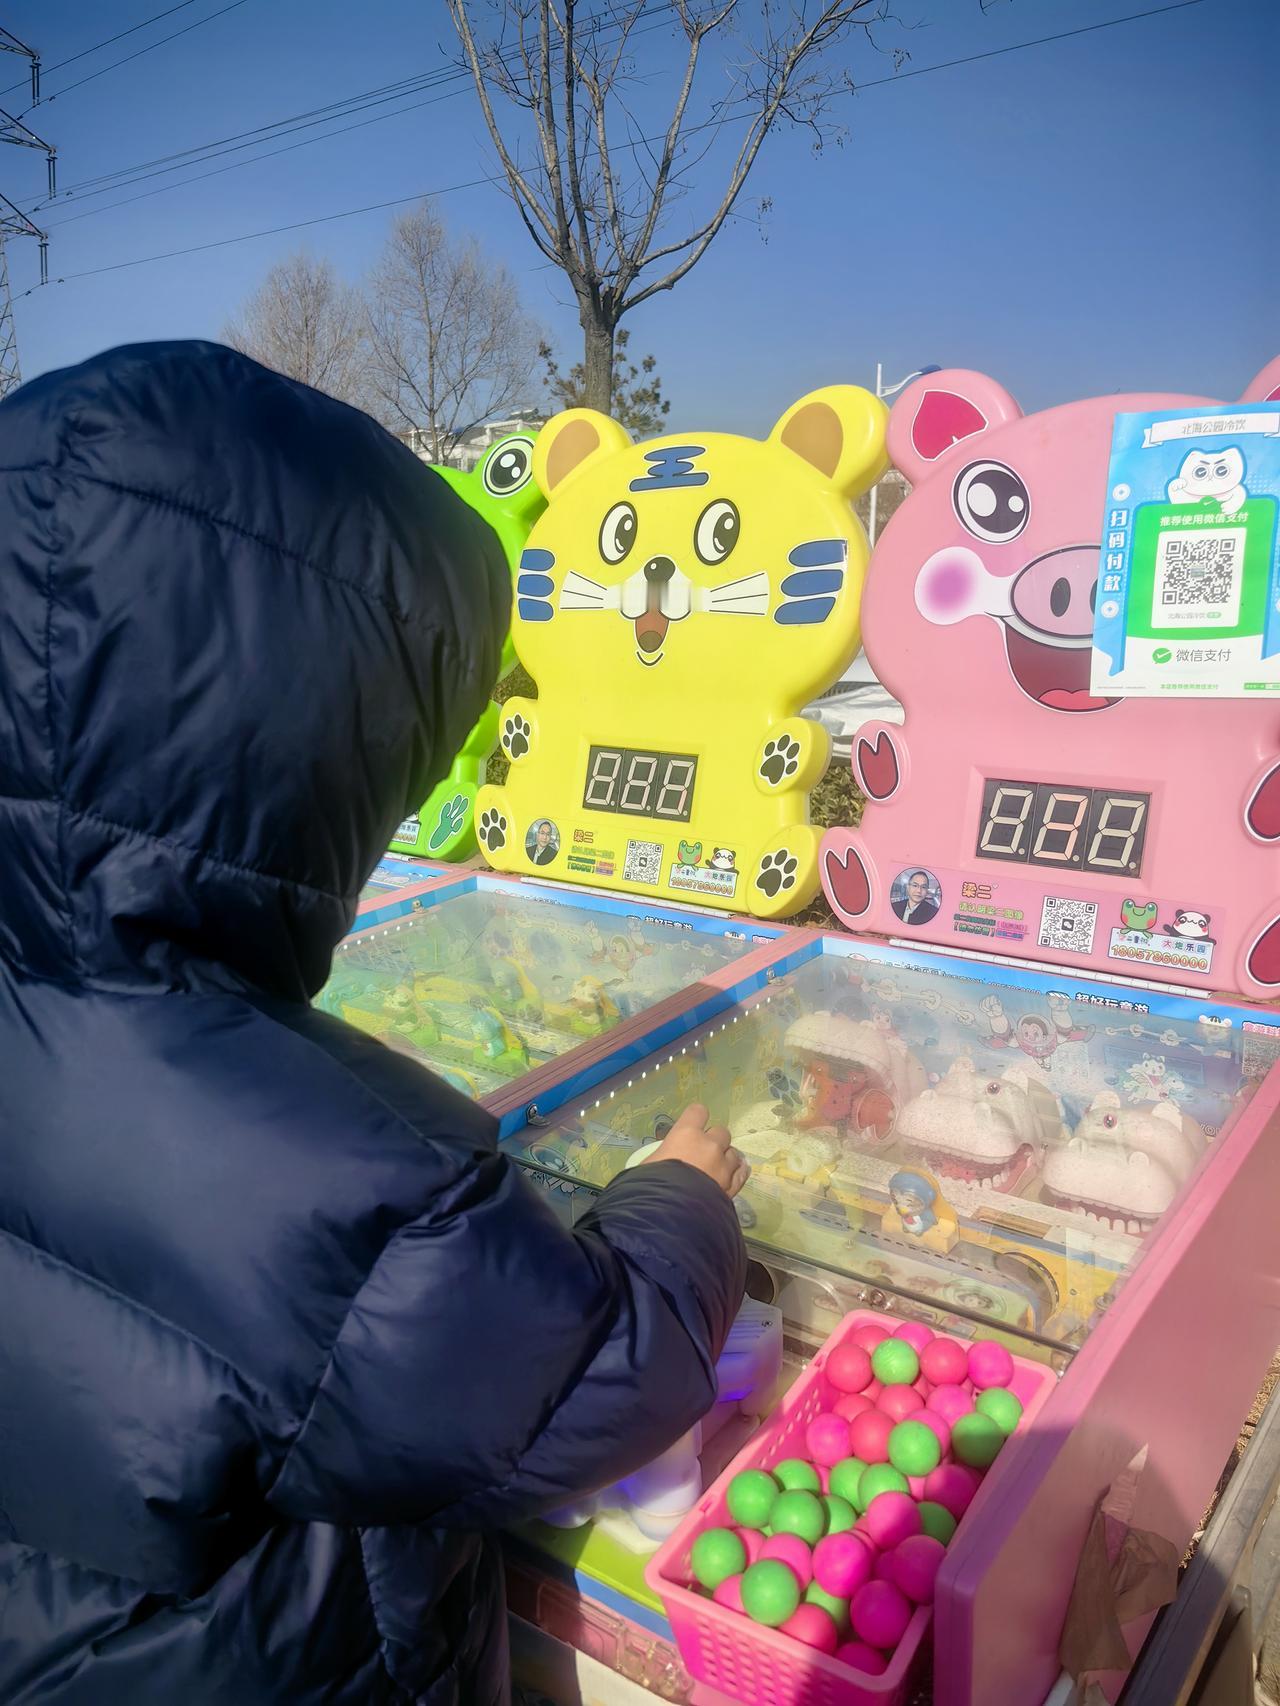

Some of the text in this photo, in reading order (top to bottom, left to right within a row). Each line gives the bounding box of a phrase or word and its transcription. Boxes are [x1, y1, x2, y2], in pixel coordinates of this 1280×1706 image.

[1160, 511, 1249, 527] 推荐使用微信支付
[1103, 509, 1127, 592] 扫码付款
[1176, 648, 1231, 663] 微信支付
[962, 881, 992, 899] 梁二
[1111, 944, 1208, 970] 18057860000
